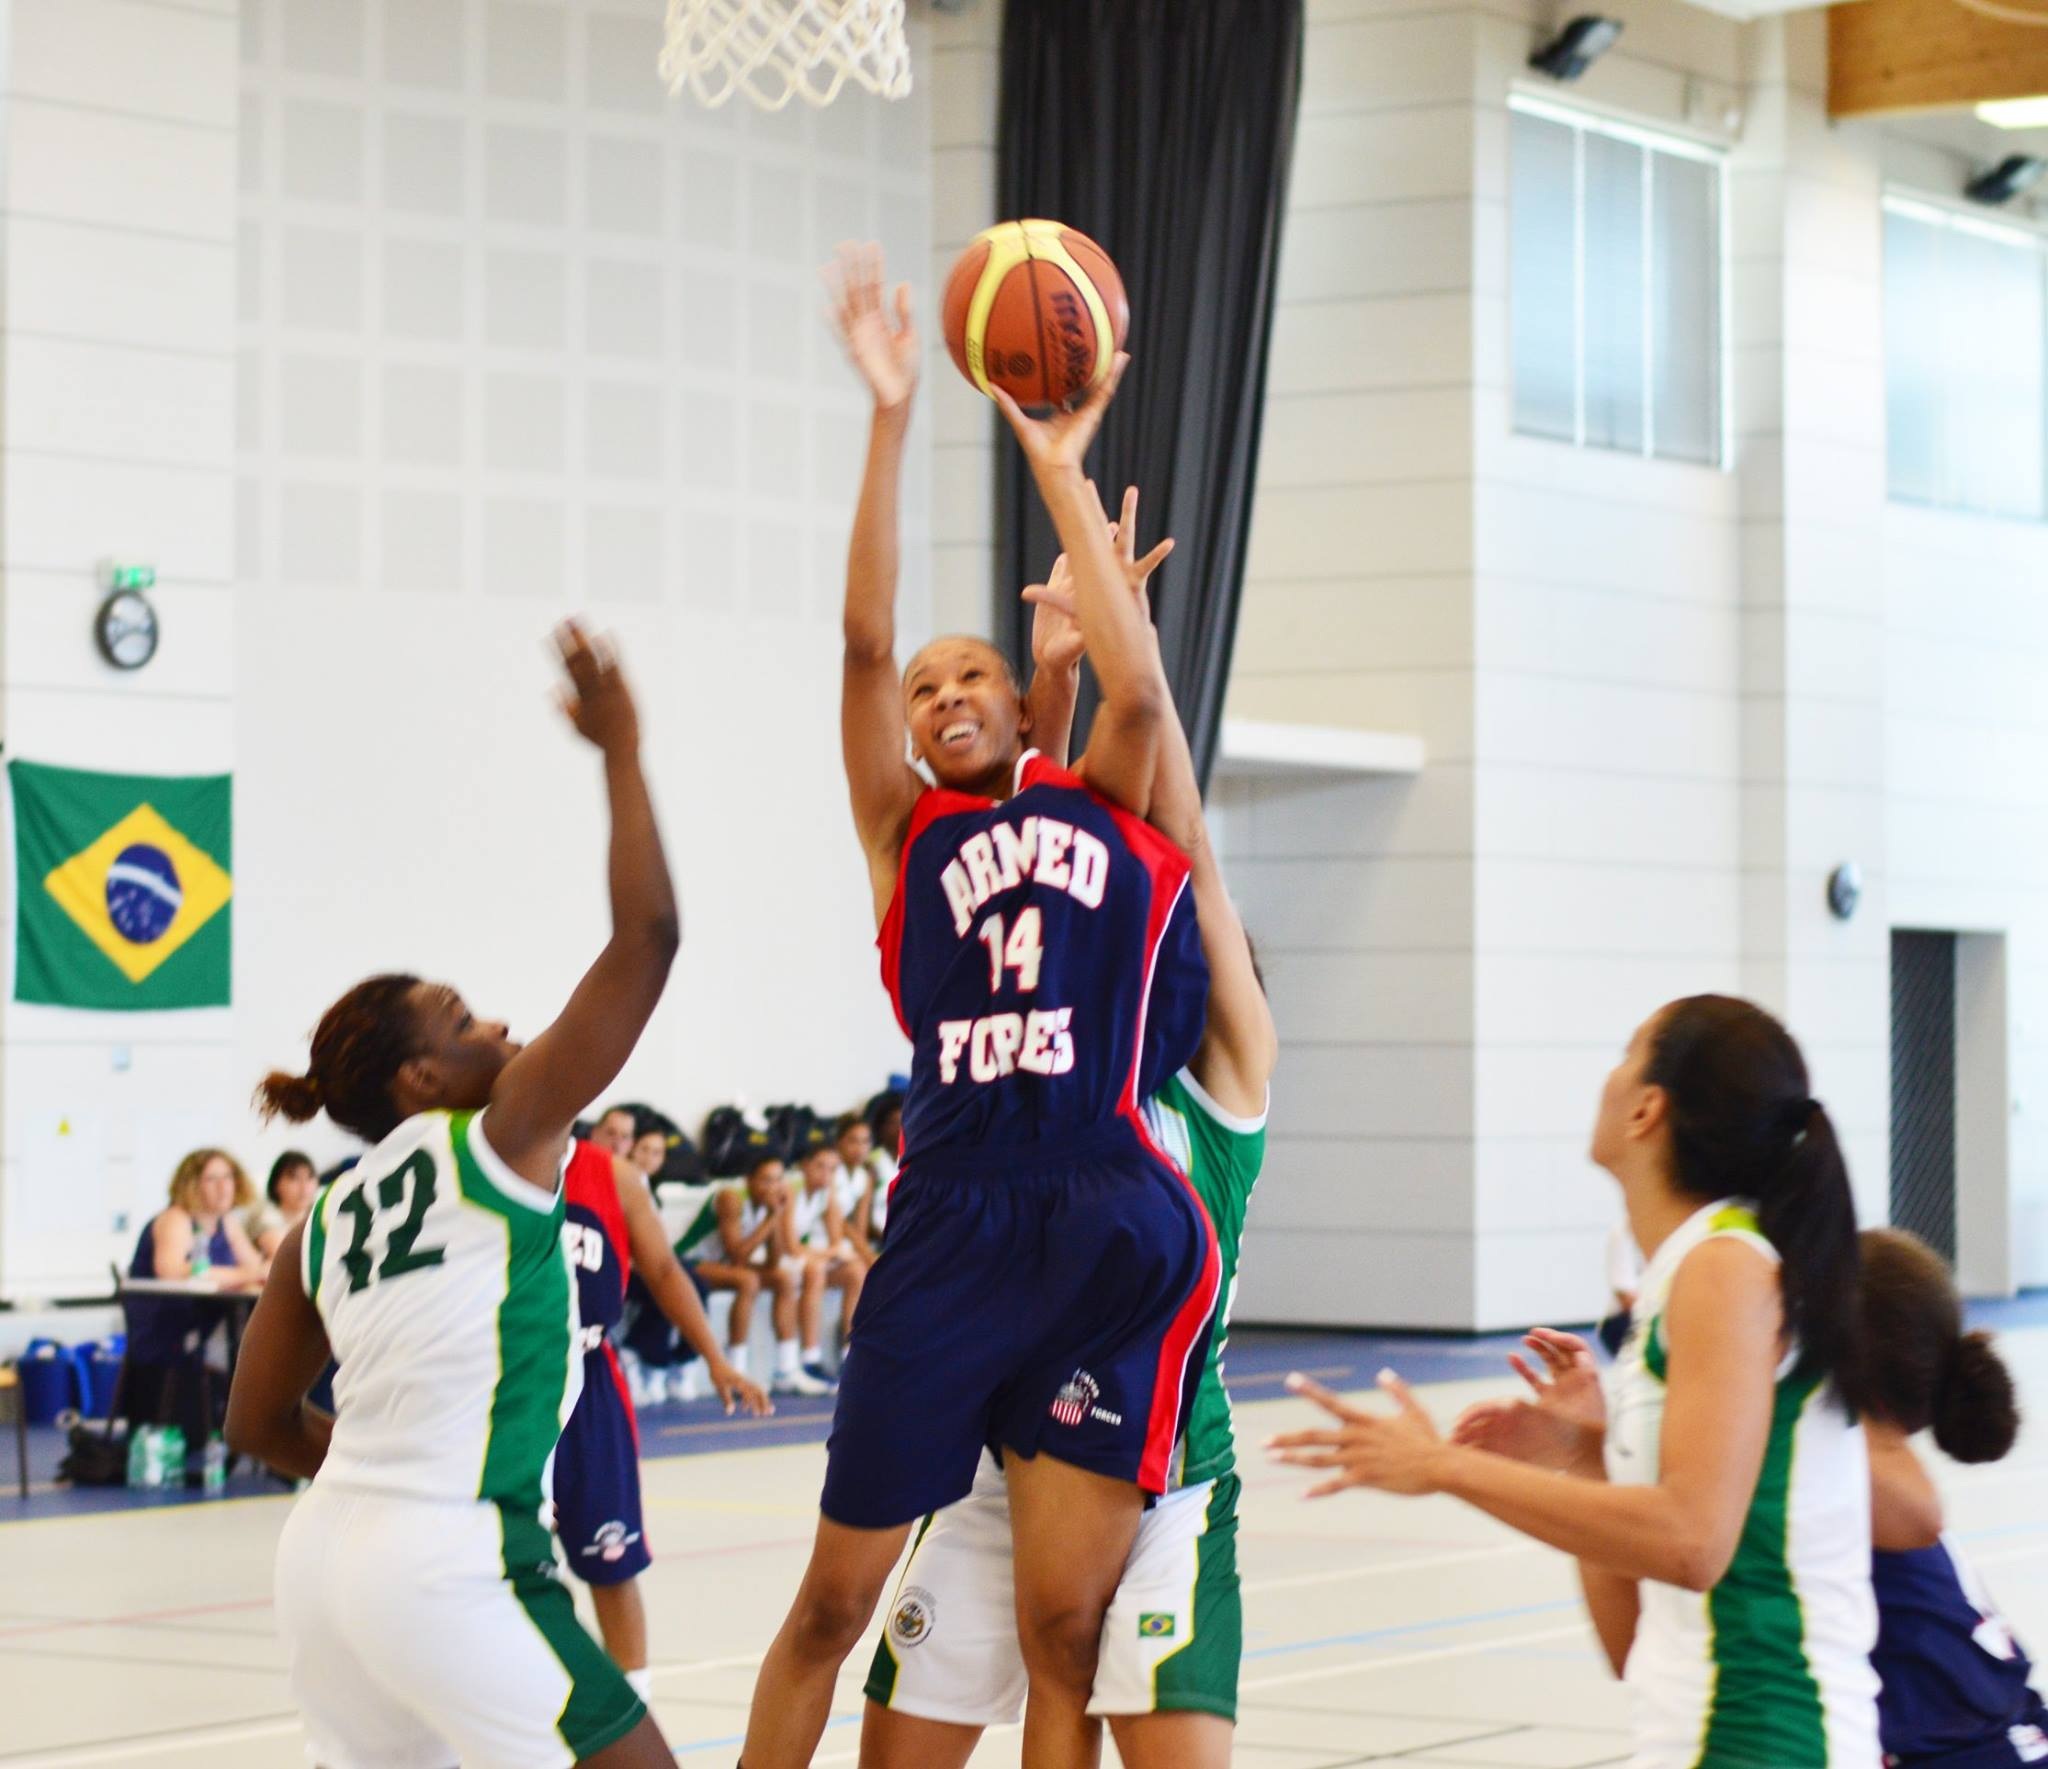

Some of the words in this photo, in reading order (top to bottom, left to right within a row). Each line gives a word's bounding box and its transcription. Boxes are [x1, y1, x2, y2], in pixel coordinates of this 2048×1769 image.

[940, 816, 1110, 938] ARMED
[979, 906, 1043, 993] 14
[337, 1147, 447, 1295] 12
